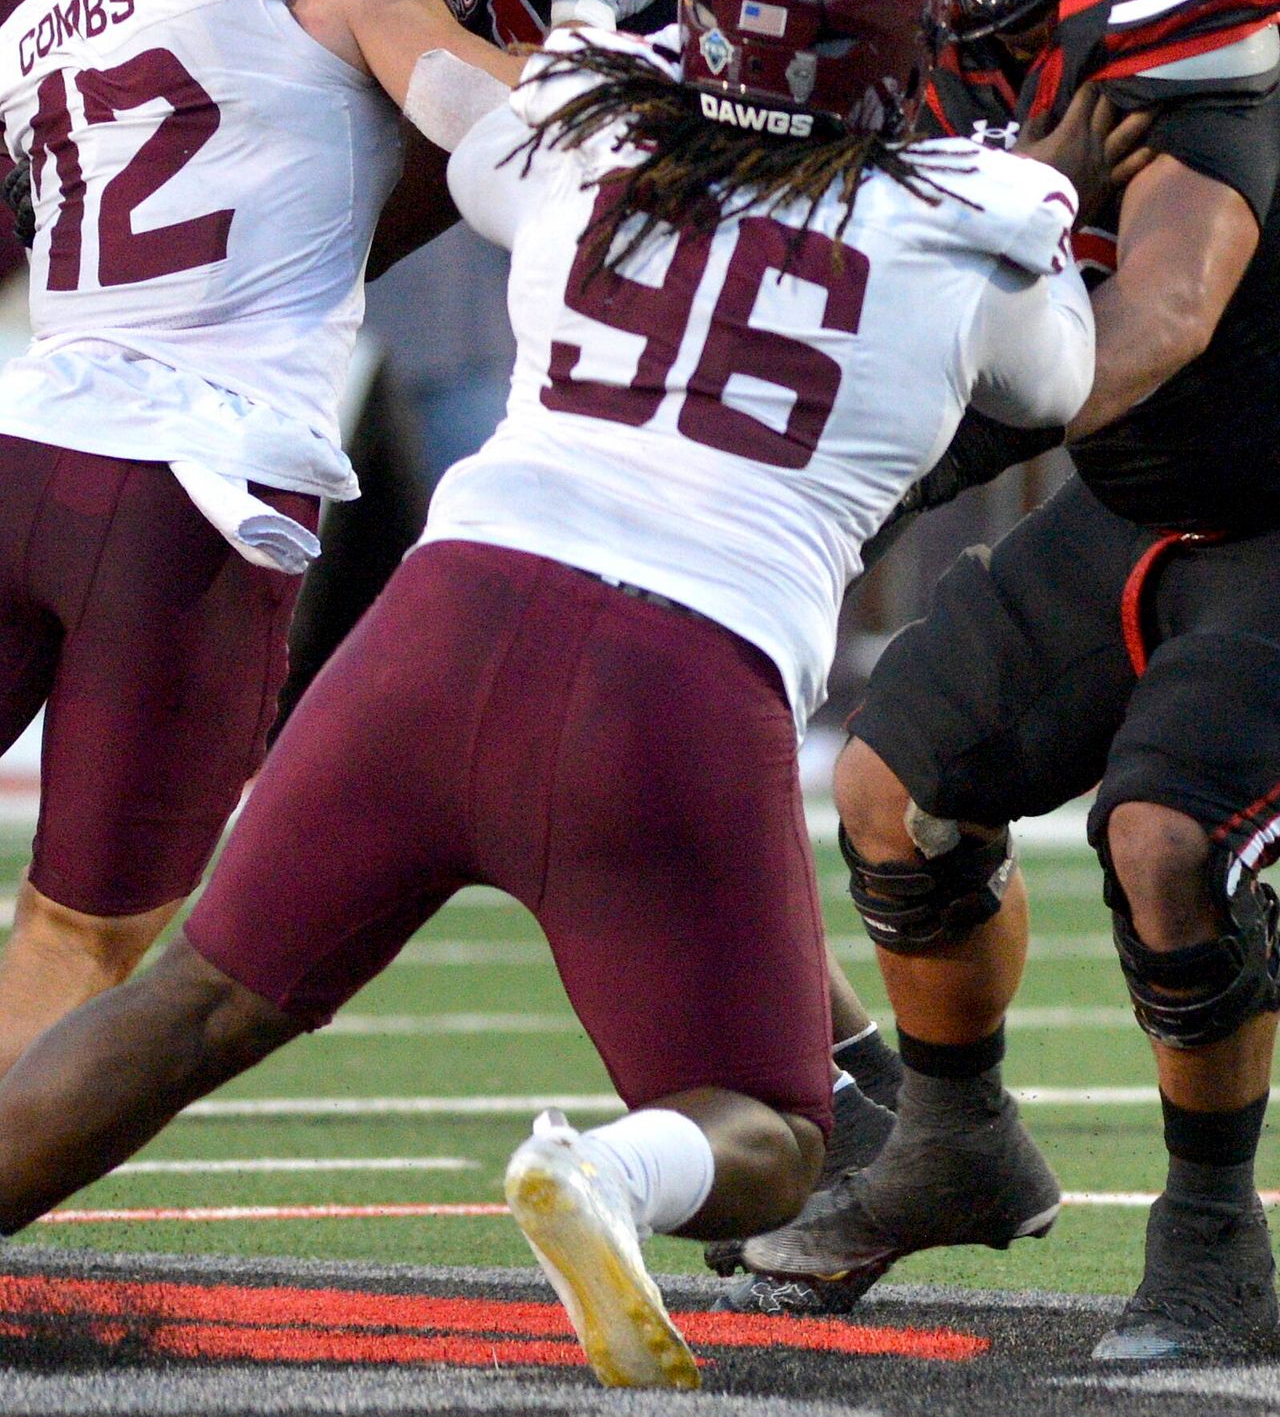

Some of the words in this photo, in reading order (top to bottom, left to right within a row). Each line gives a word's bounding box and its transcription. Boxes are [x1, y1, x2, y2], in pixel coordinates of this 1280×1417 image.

[44, 47, 237, 292] 12
[700, 92, 815, 138] DAWGS
[539, 166, 870, 470] 96
